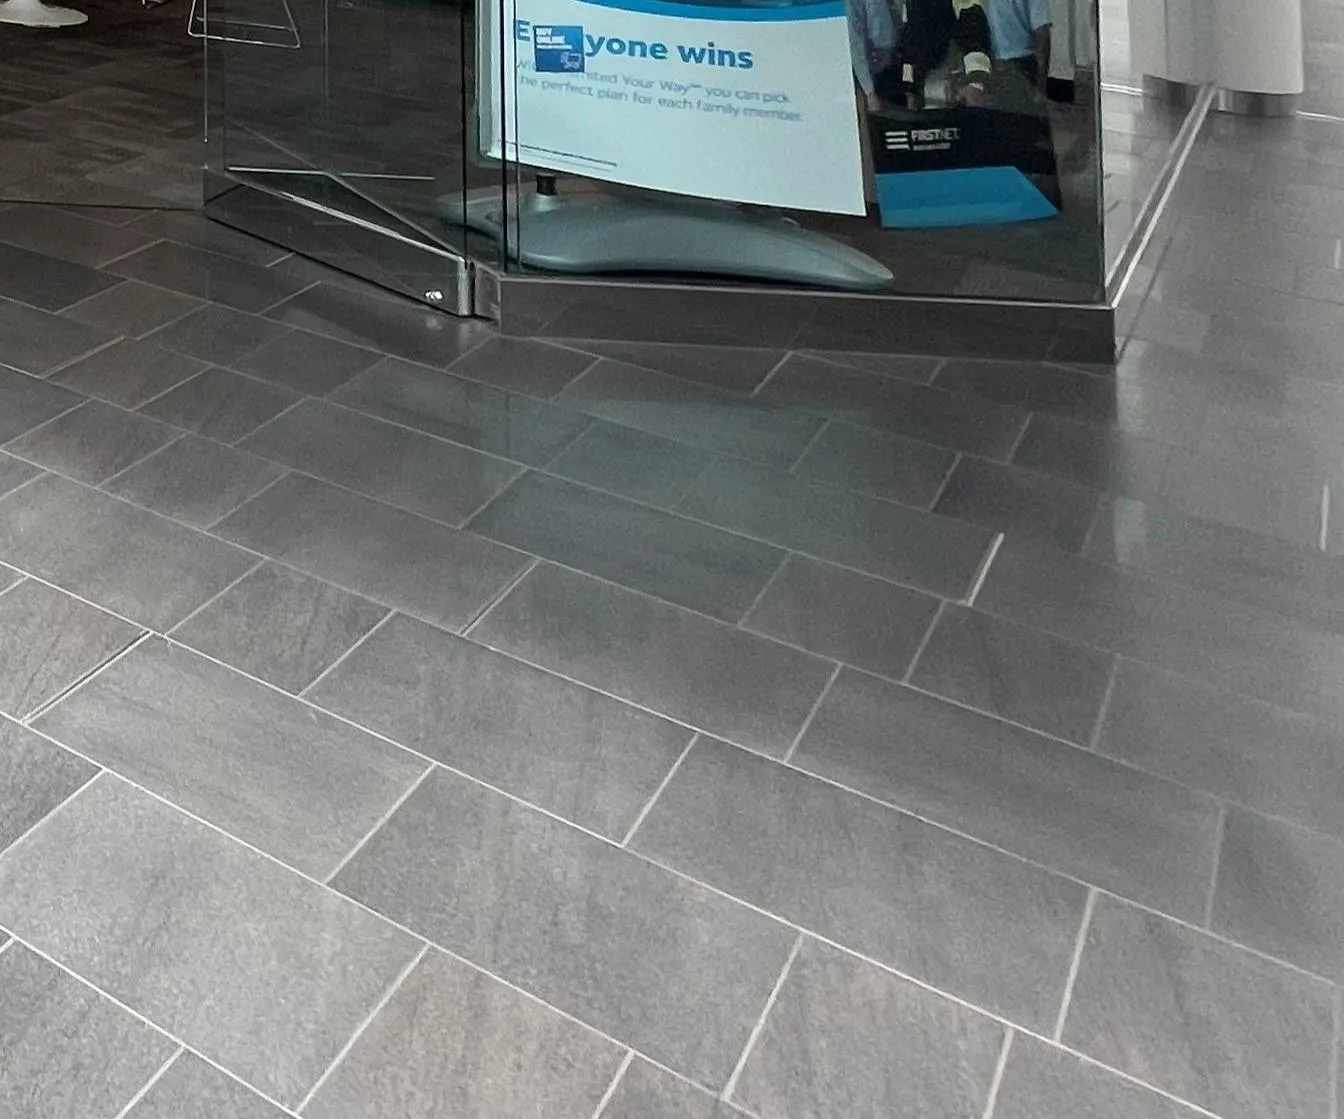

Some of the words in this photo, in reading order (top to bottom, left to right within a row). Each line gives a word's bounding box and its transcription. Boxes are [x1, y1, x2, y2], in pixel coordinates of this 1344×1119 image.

[515, 19, 668, 60] Eyone
[677, 41, 754, 69] wins
[541, 79, 594, 97] perfect
[597, 88, 628, 102] plan
[633, 91, 653, 105] for
[658, 96, 692, 110] each
[696, 99, 740, 117] family
[621, 74, 654, 89] Your
[705, 86, 732, 98] you
[735, 90, 760, 101] can
[762, 91, 790, 104] pick
